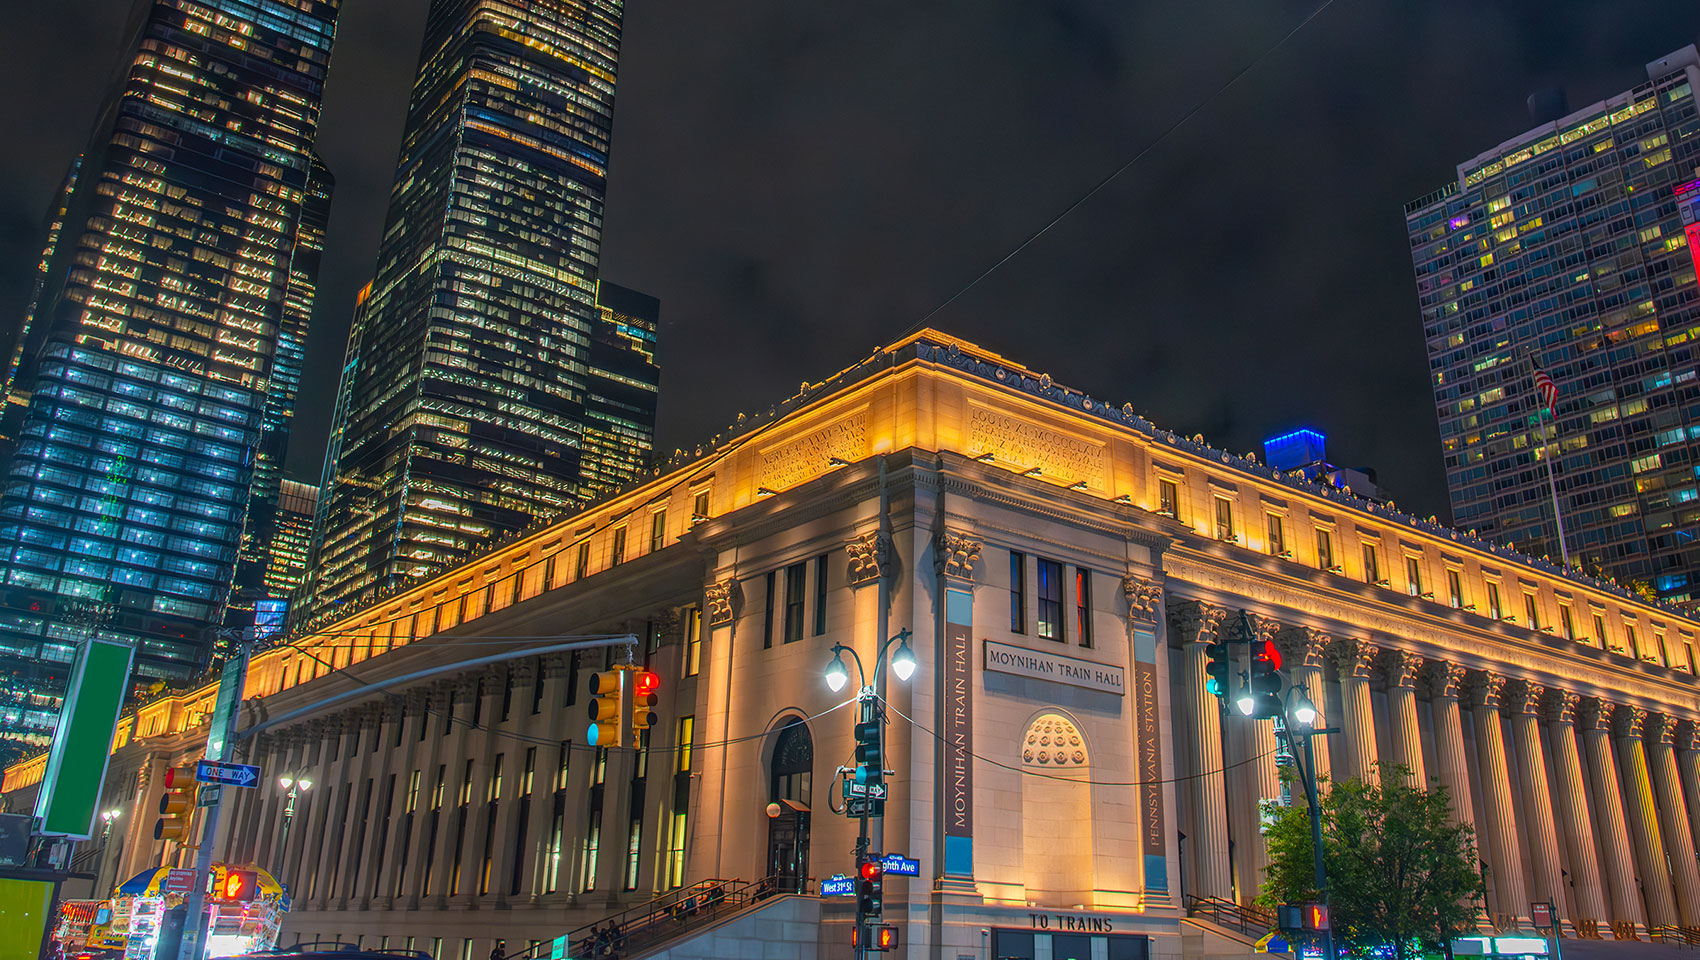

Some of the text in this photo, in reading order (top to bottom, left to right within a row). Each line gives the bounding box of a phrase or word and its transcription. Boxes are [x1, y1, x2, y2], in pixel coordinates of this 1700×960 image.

[972, 407, 1009, 429] LOUIS
[1167, 562, 1238, 592] NEITHER
[1248, 583, 1286, 605] SNOW
[990, 651, 1121, 687] MOYNIHAN TRAIN HALL
[955, 633, 966, 828] MOYNIHAN TRAIN HALL
[1143, 671, 1160, 846] PENNSYLVANIA STATION
[206, 767, 251, 780] ONE WAY
[901, 862, 915, 872] Ave
[824, 883, 836, 892] West
[846, 881, 852, 891] St
[1029, 914, 1113, 933] TO TRAINS
